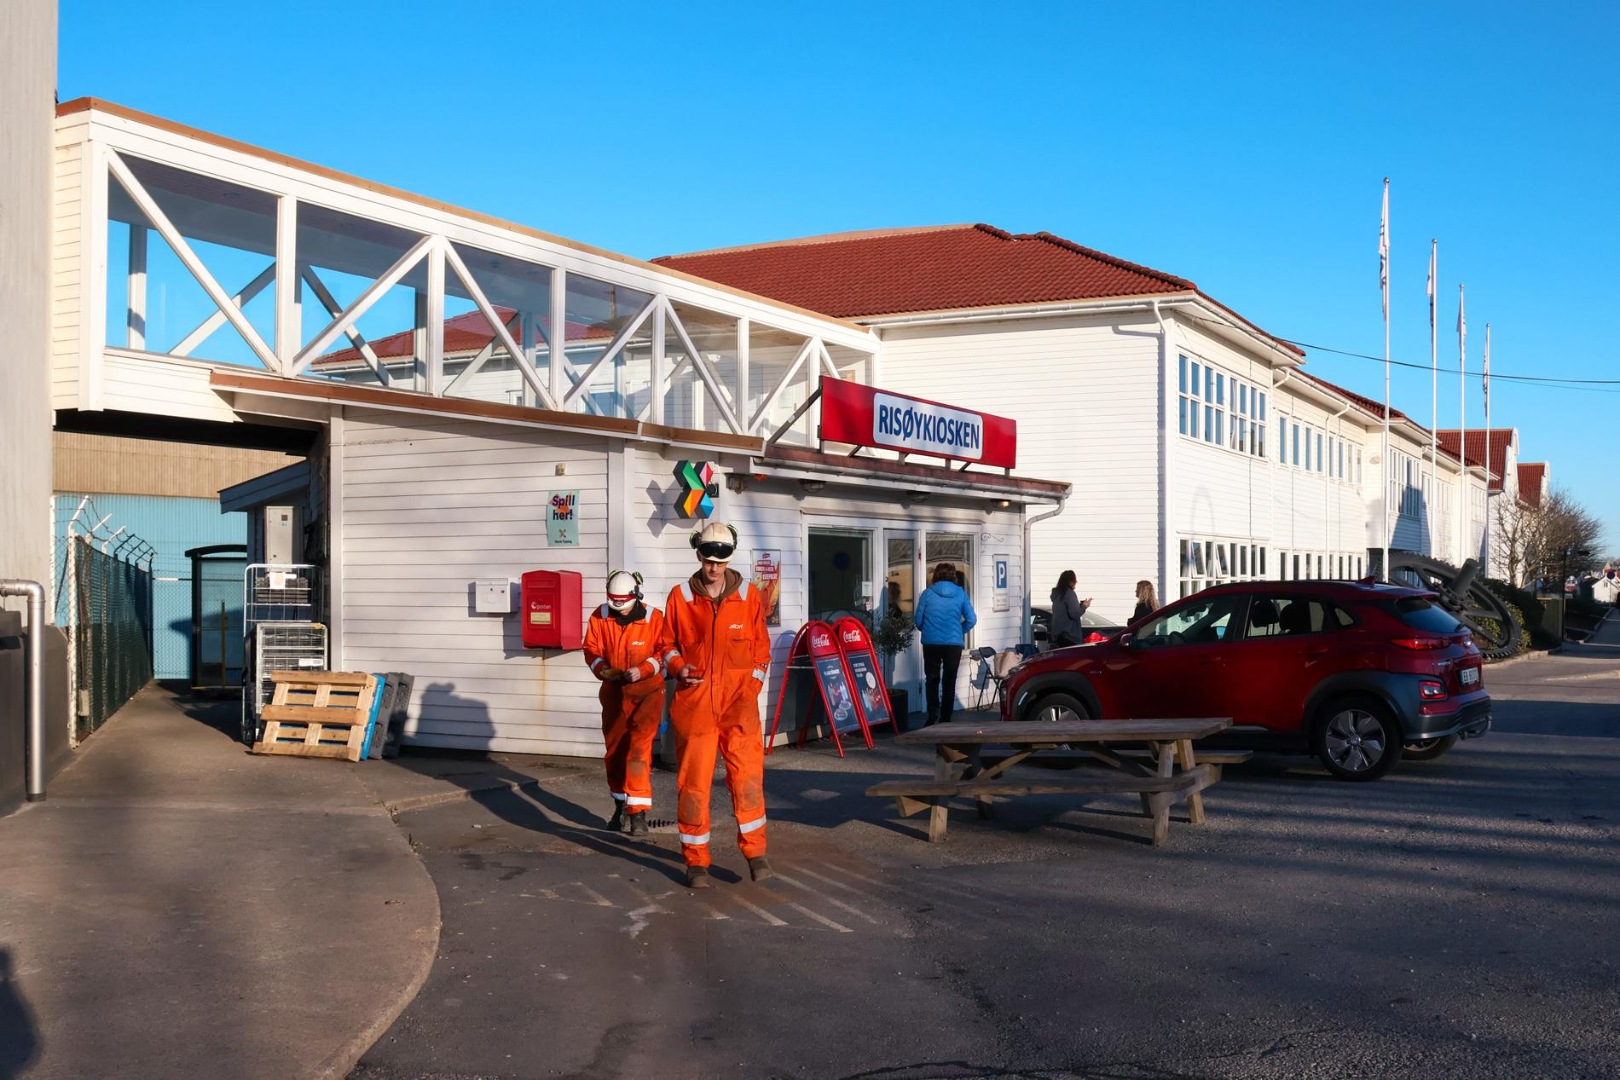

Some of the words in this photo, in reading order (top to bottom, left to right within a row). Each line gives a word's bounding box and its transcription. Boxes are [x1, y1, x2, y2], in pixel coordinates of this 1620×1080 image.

[878, 404, 980, 449] RISØYKIOSKEN
[552, 494, 575, 508] Spill
[552, 509, 573, 520] her!
[998, 563, 1006, 586] P
